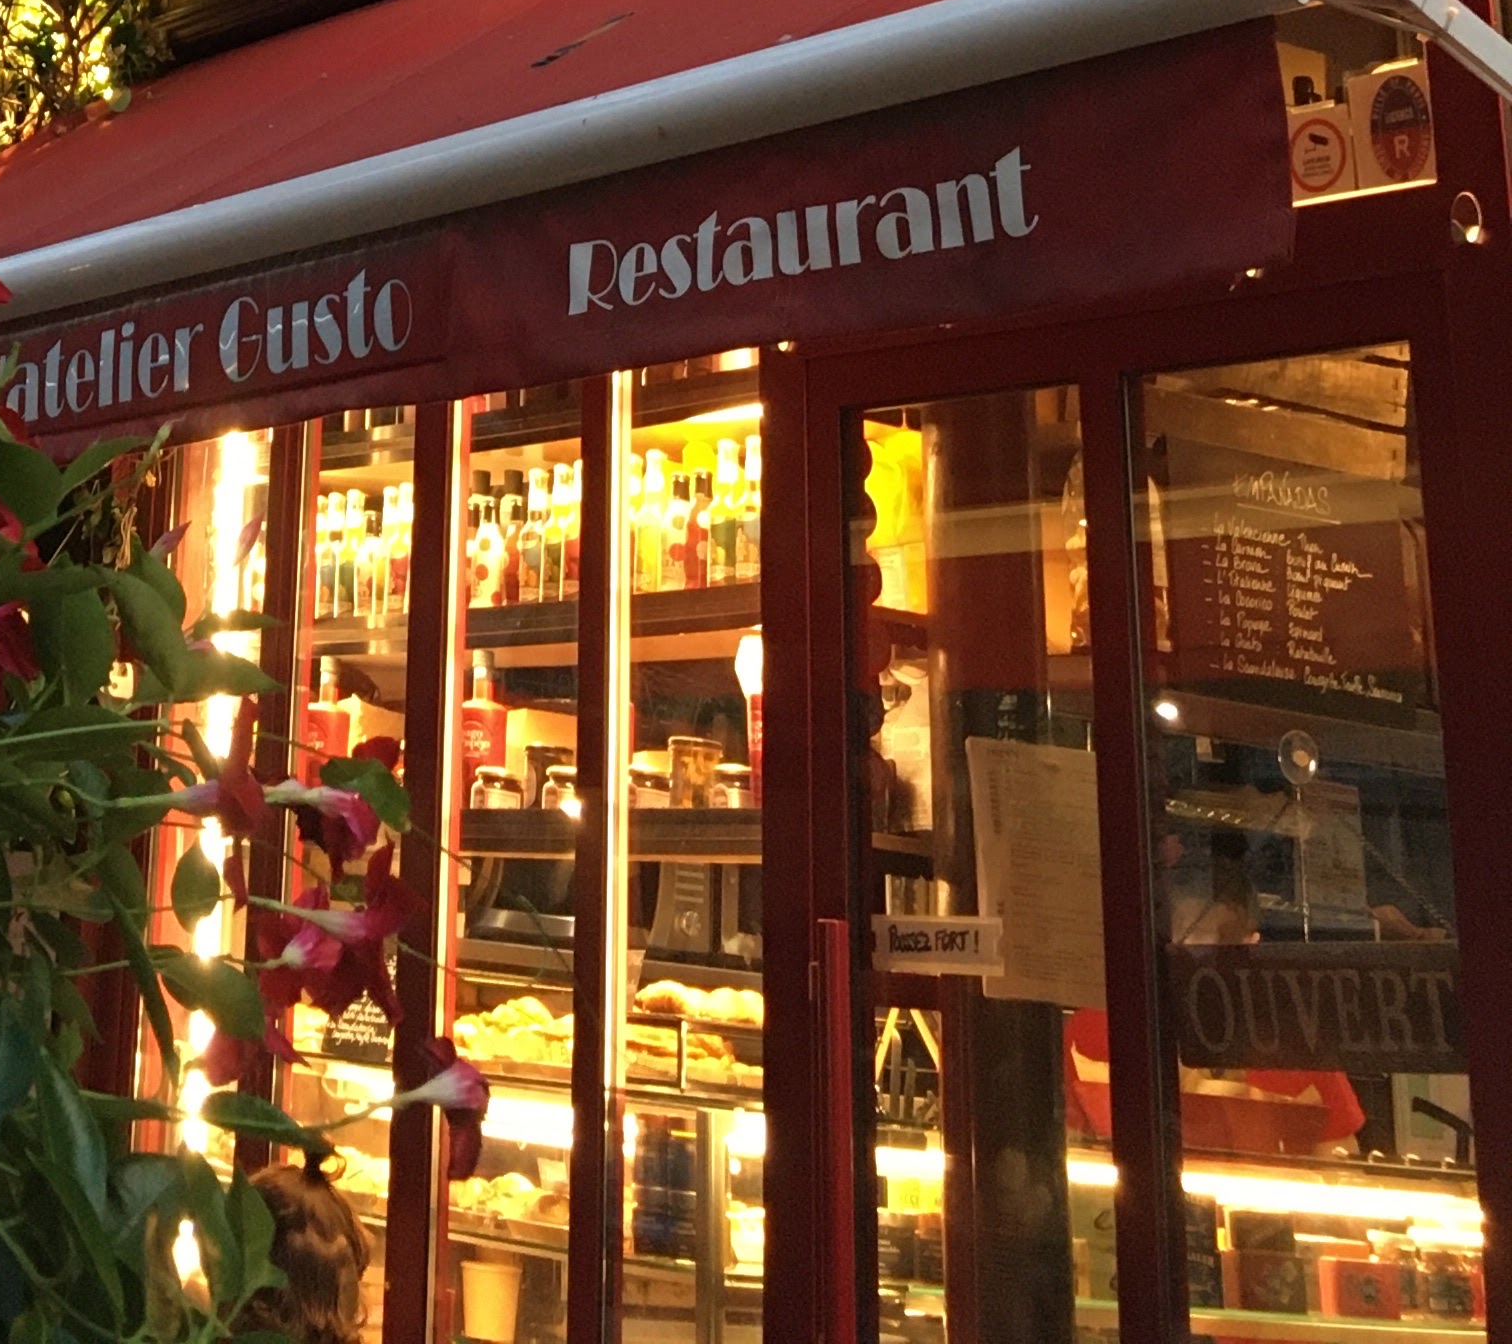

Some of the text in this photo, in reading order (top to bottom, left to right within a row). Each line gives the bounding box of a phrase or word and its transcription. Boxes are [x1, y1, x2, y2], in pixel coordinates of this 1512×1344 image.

[1393, 135, 1410, 160] R
[568, 145, 1040, 316] Restaurant
[218, 268, 413, 384] Gusto
[934, 929, 970, 952] FORT
[1190, 967, 1455, 1054] OUVERT
